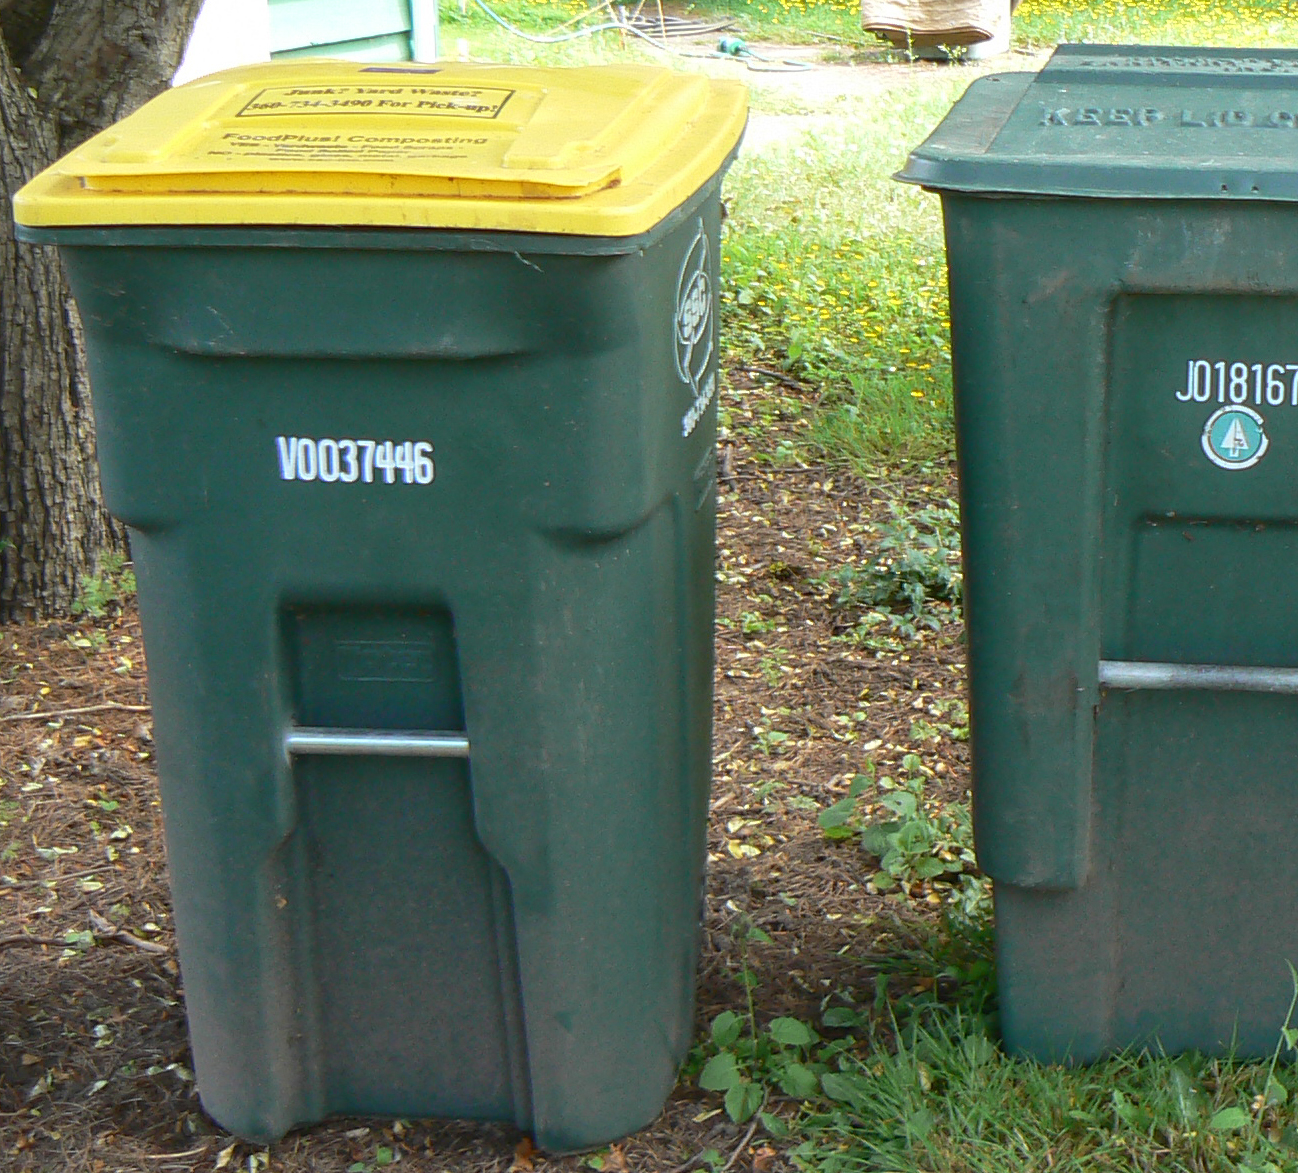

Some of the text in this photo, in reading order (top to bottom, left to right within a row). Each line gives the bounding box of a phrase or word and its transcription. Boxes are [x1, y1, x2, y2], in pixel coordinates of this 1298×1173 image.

[282, 87, 482, 98] Junk? Yard Waste?
[246, 99, 500, 114] 360-734-3490 For Pick-up!
[1038, 105, 1162, 127] KEEP
[1179, 108, 1255, 130] LID
[222, 132, 489, 145] FoodPlus! Composting
[275, 435, 435, 485] V0037446
